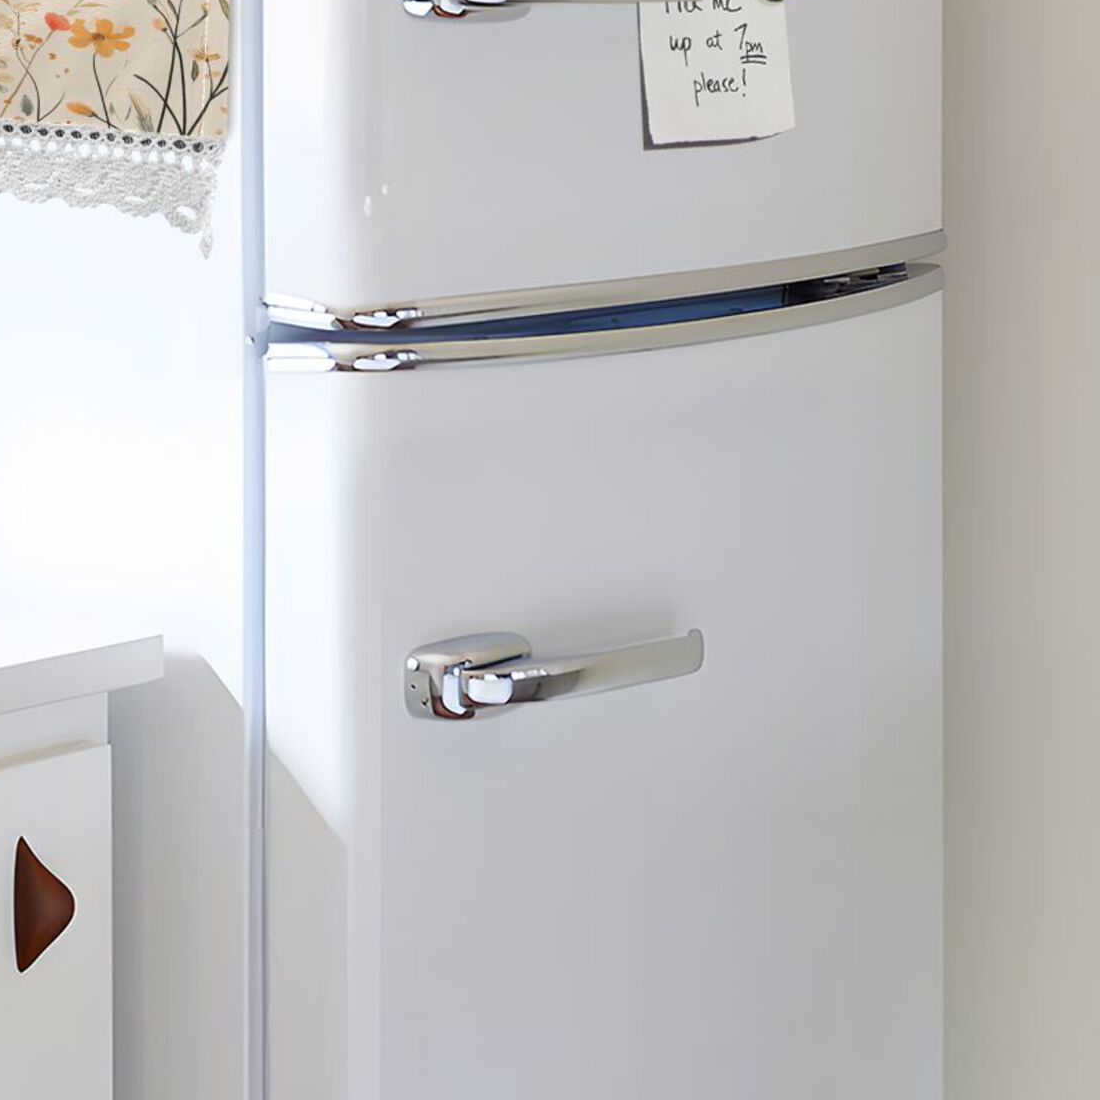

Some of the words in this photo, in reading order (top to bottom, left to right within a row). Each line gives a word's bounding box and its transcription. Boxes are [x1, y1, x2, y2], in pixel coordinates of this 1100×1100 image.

[669, 35, 692, 66] up
[706, 30, 724, 51] at
[693, 68, 747, 107] please!
